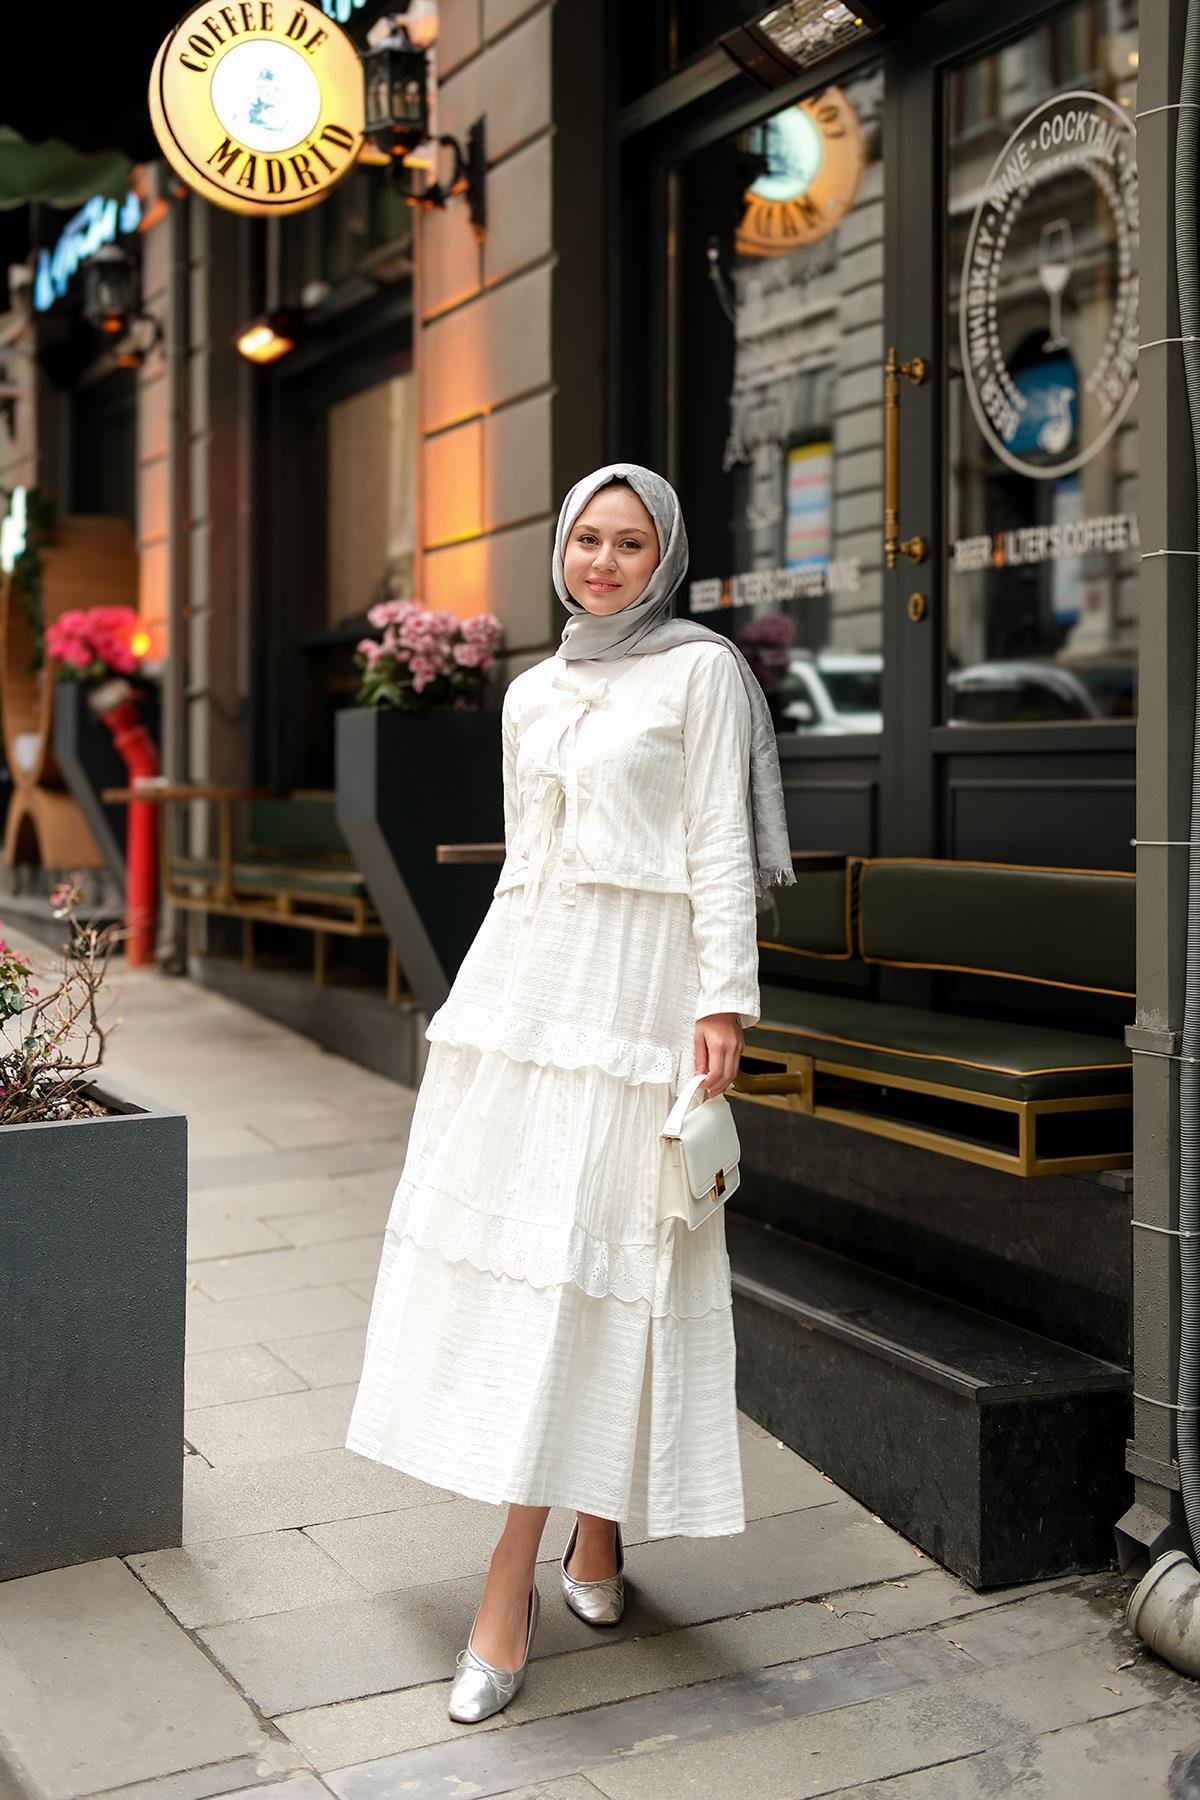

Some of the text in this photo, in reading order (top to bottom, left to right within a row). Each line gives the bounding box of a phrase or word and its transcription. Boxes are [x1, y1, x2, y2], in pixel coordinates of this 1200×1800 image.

[179, 1, 274, 73] COFFEE
[989, 142, 1031, 214] WINE
[1039, 110, 1120, 165] COCKTAIL
